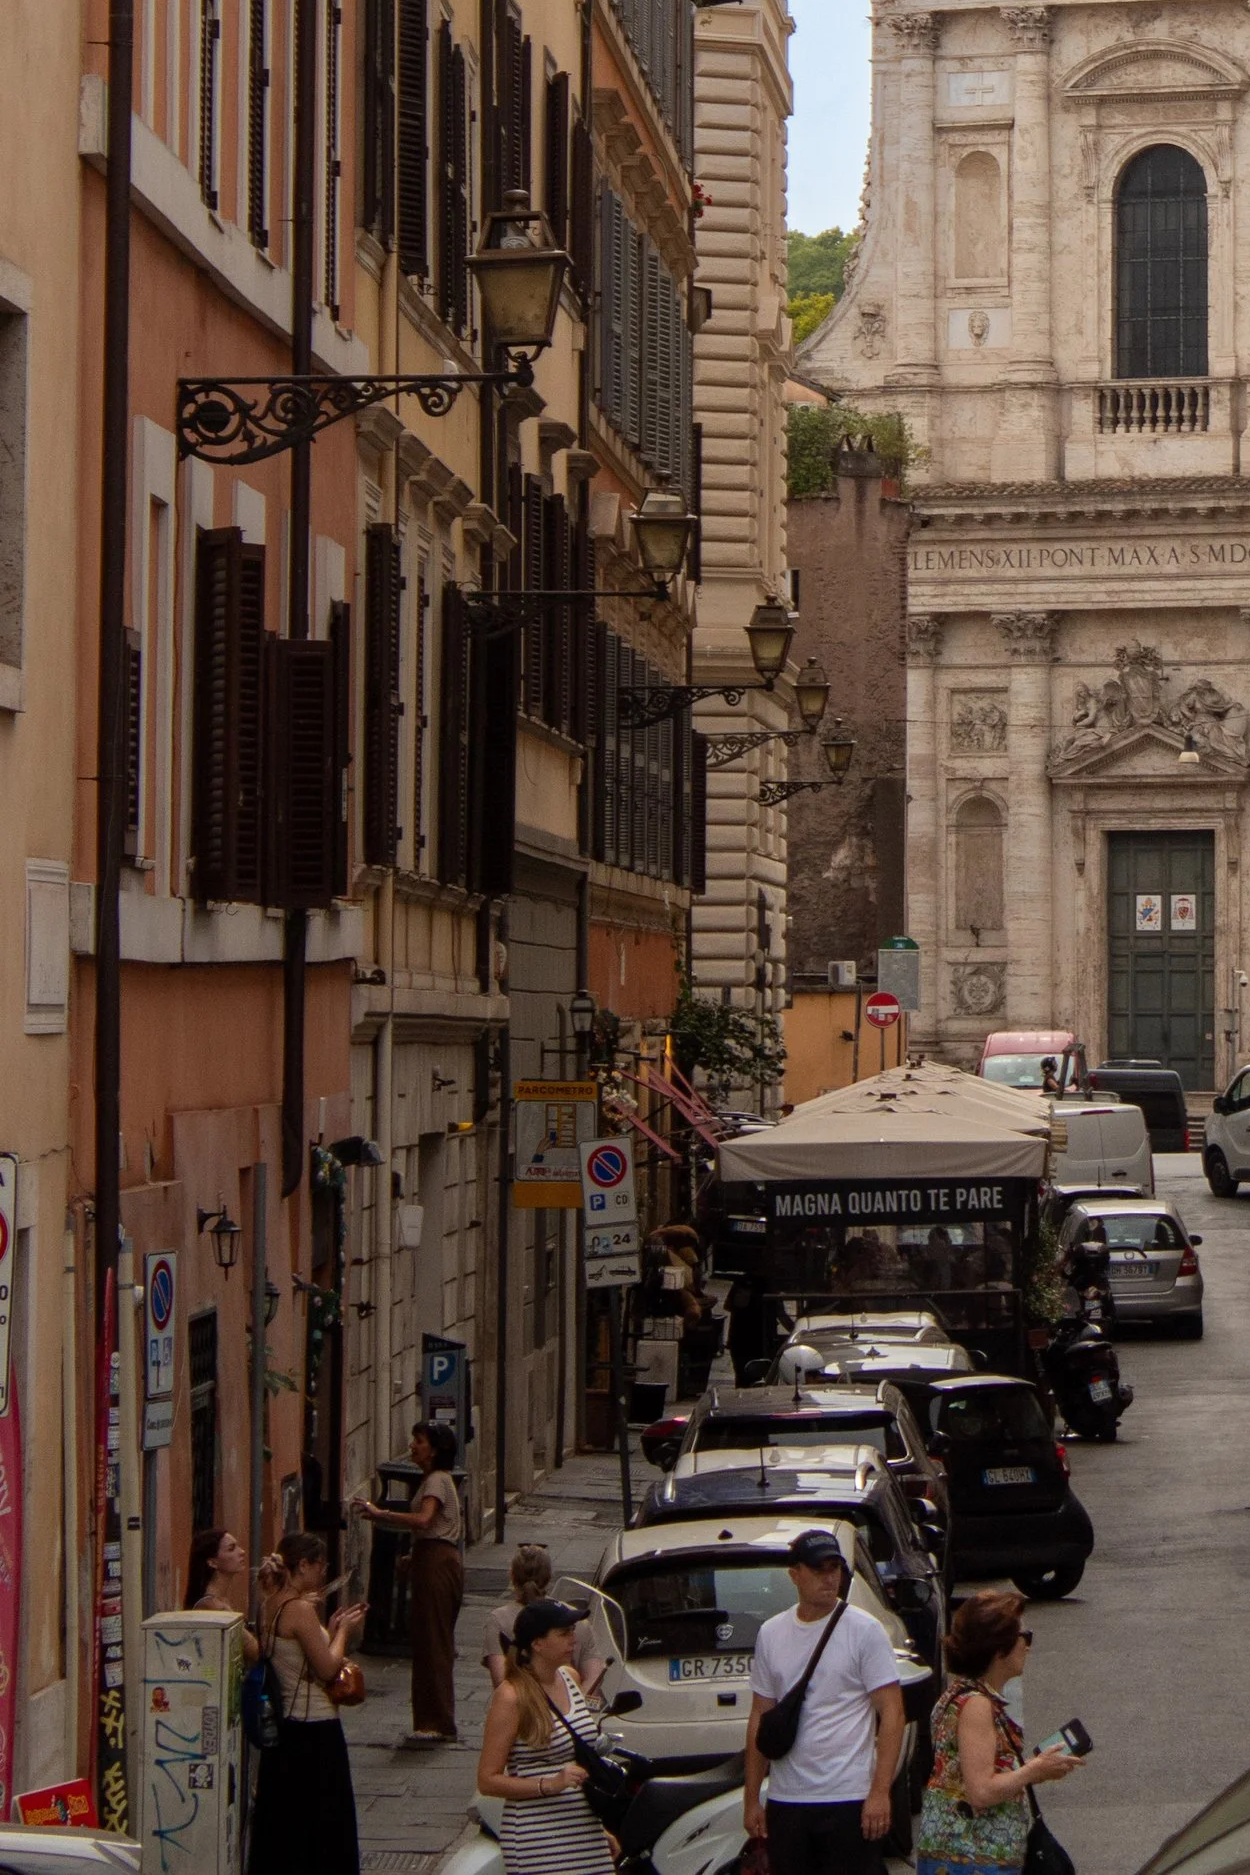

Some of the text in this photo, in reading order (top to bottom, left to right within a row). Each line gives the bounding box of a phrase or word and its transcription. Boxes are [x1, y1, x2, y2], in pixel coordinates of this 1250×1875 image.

[908, 548, 995, 570] LEMENS
[1001, 549, 1031, 568] XII
[1039, 547, 1099, 568] PONT
[1106, 546, 1158, 567] MAX
[518, 1085, 593, 1095] PARCOMETRO
[615, 1193, 628, 1205] CD
[775, 1186, 1004, 1217] MAGNA QUANTO TE PARE
[682, 1659, 704, 1677] GR
